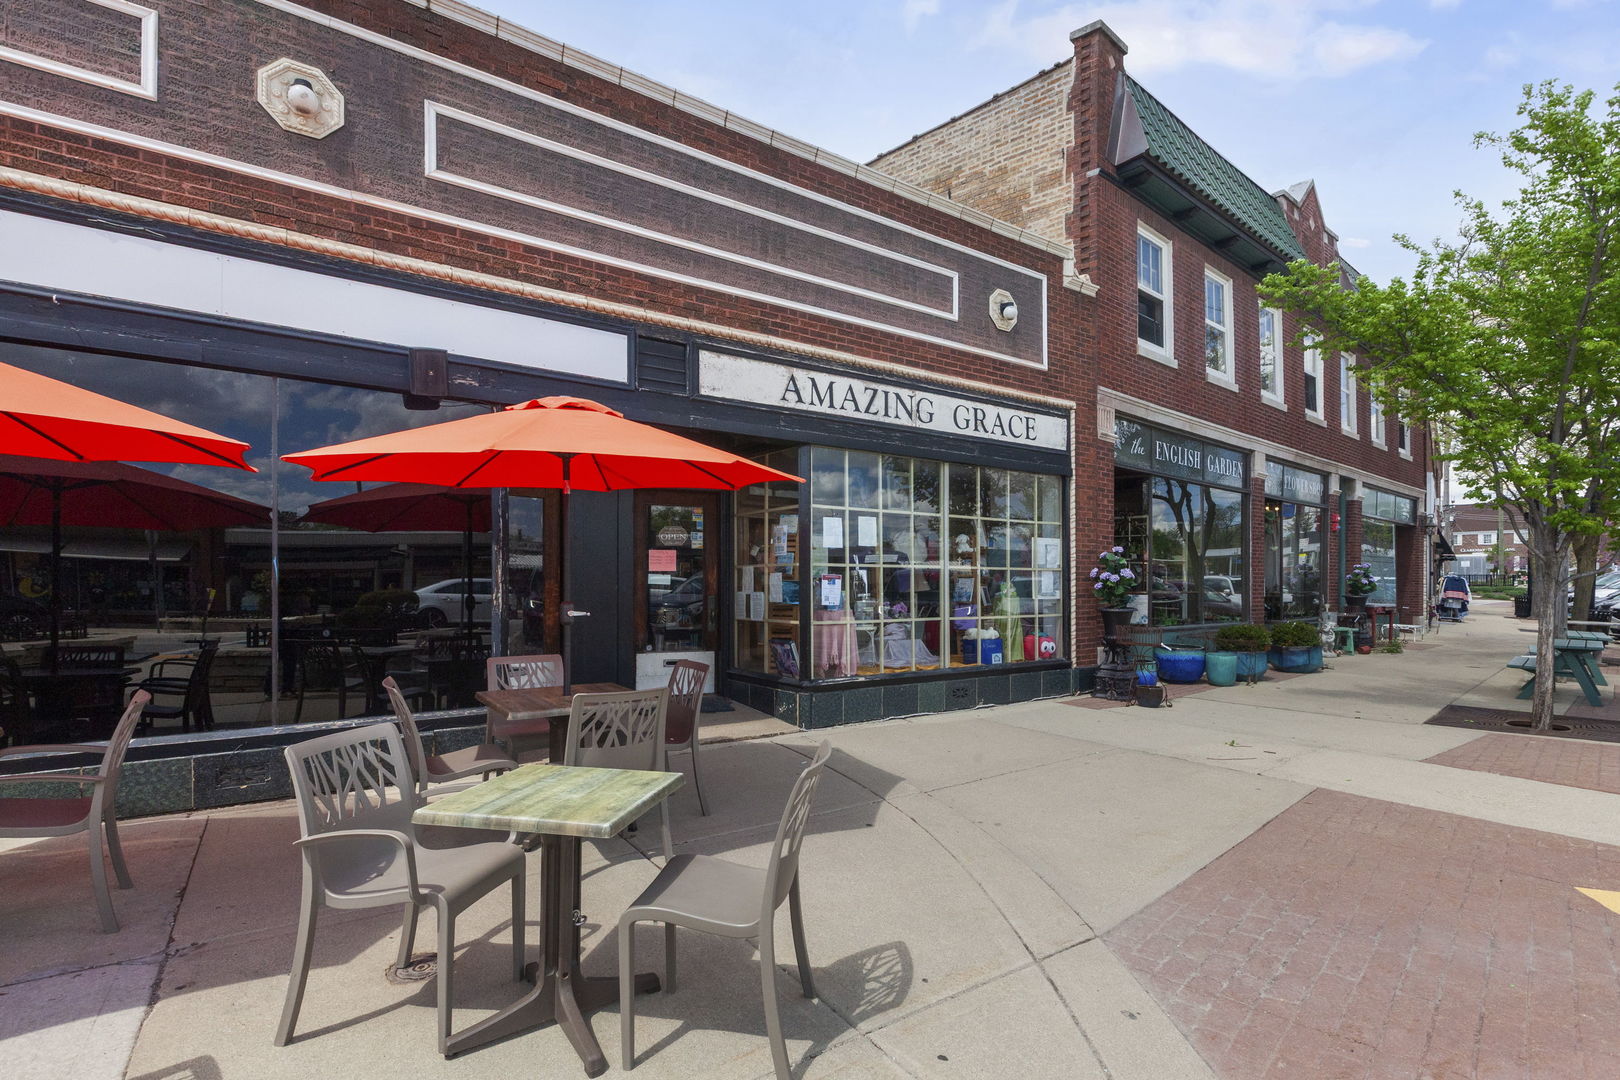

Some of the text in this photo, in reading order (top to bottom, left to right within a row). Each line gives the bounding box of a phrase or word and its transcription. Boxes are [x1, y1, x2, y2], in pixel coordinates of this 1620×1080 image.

[780, 373, 1038, 441] AMAZING GRACE
[1130, 437, 1243, 479] the ENGLISH GARDEN
[660, 533, 687, 541] OPEN
